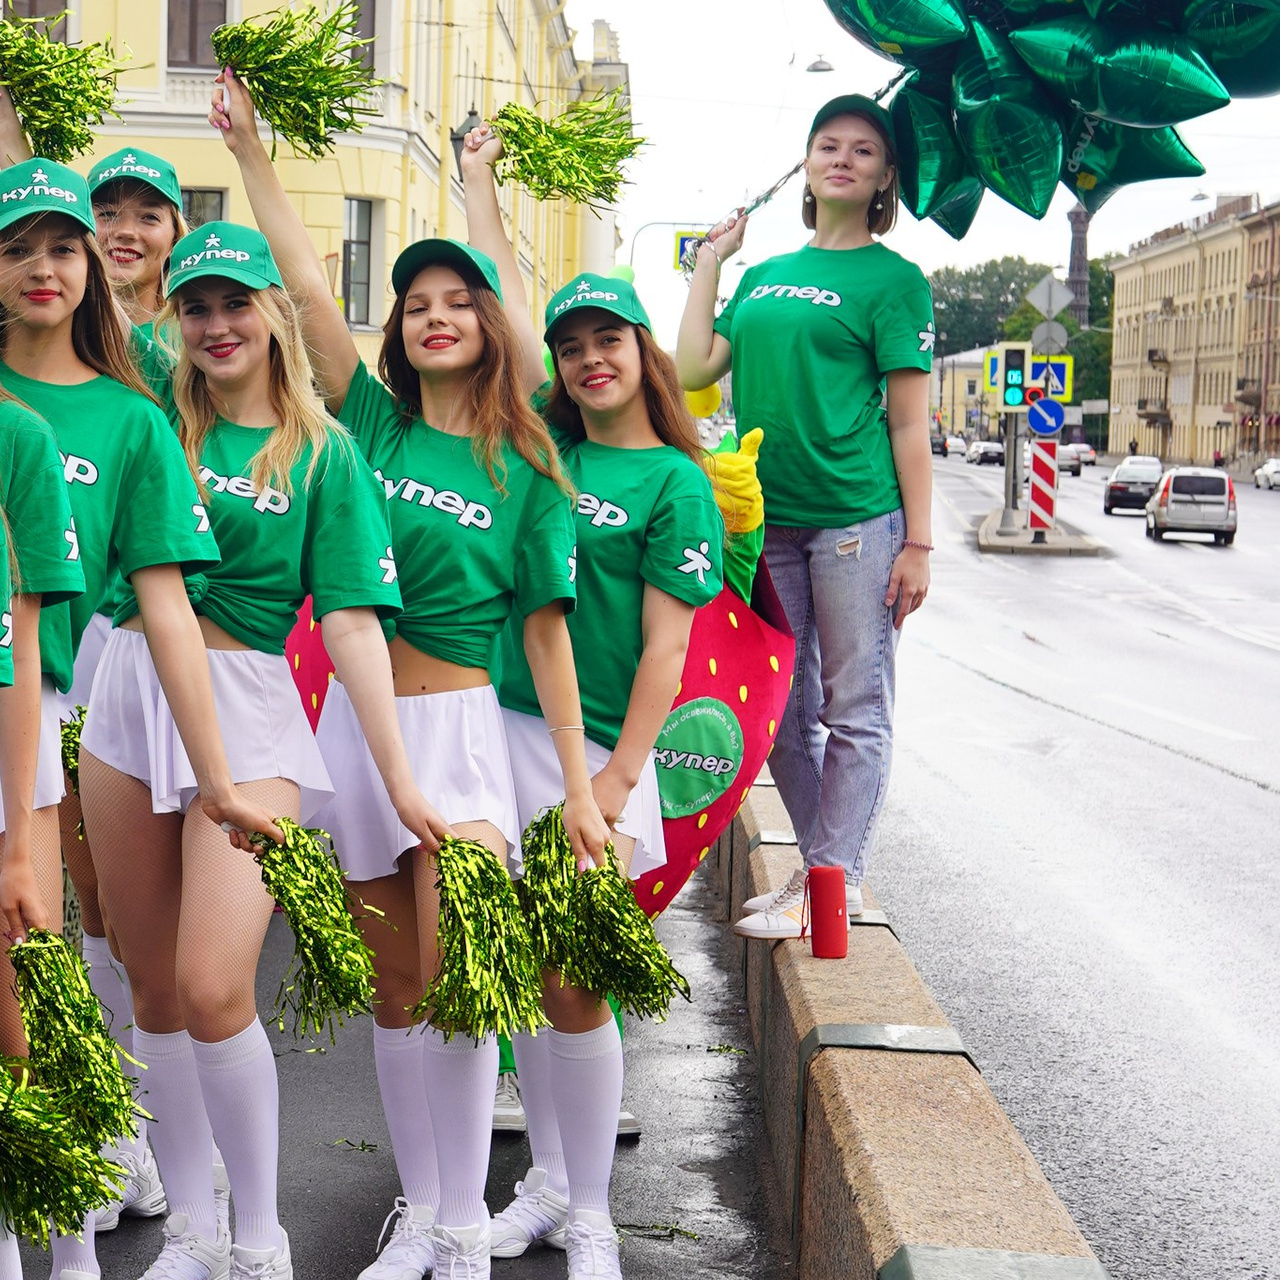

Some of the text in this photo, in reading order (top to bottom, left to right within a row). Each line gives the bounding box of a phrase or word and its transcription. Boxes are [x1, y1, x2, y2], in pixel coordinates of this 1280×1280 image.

[1066, 116, 1099, 173] упер
[99, 164, 161, 181] купер
[1, 185, 78, 203] купер
[180, 249, 250, 270] купер
[554, 291, 618, 314] купер
[652, 746, 734, 776] купер
